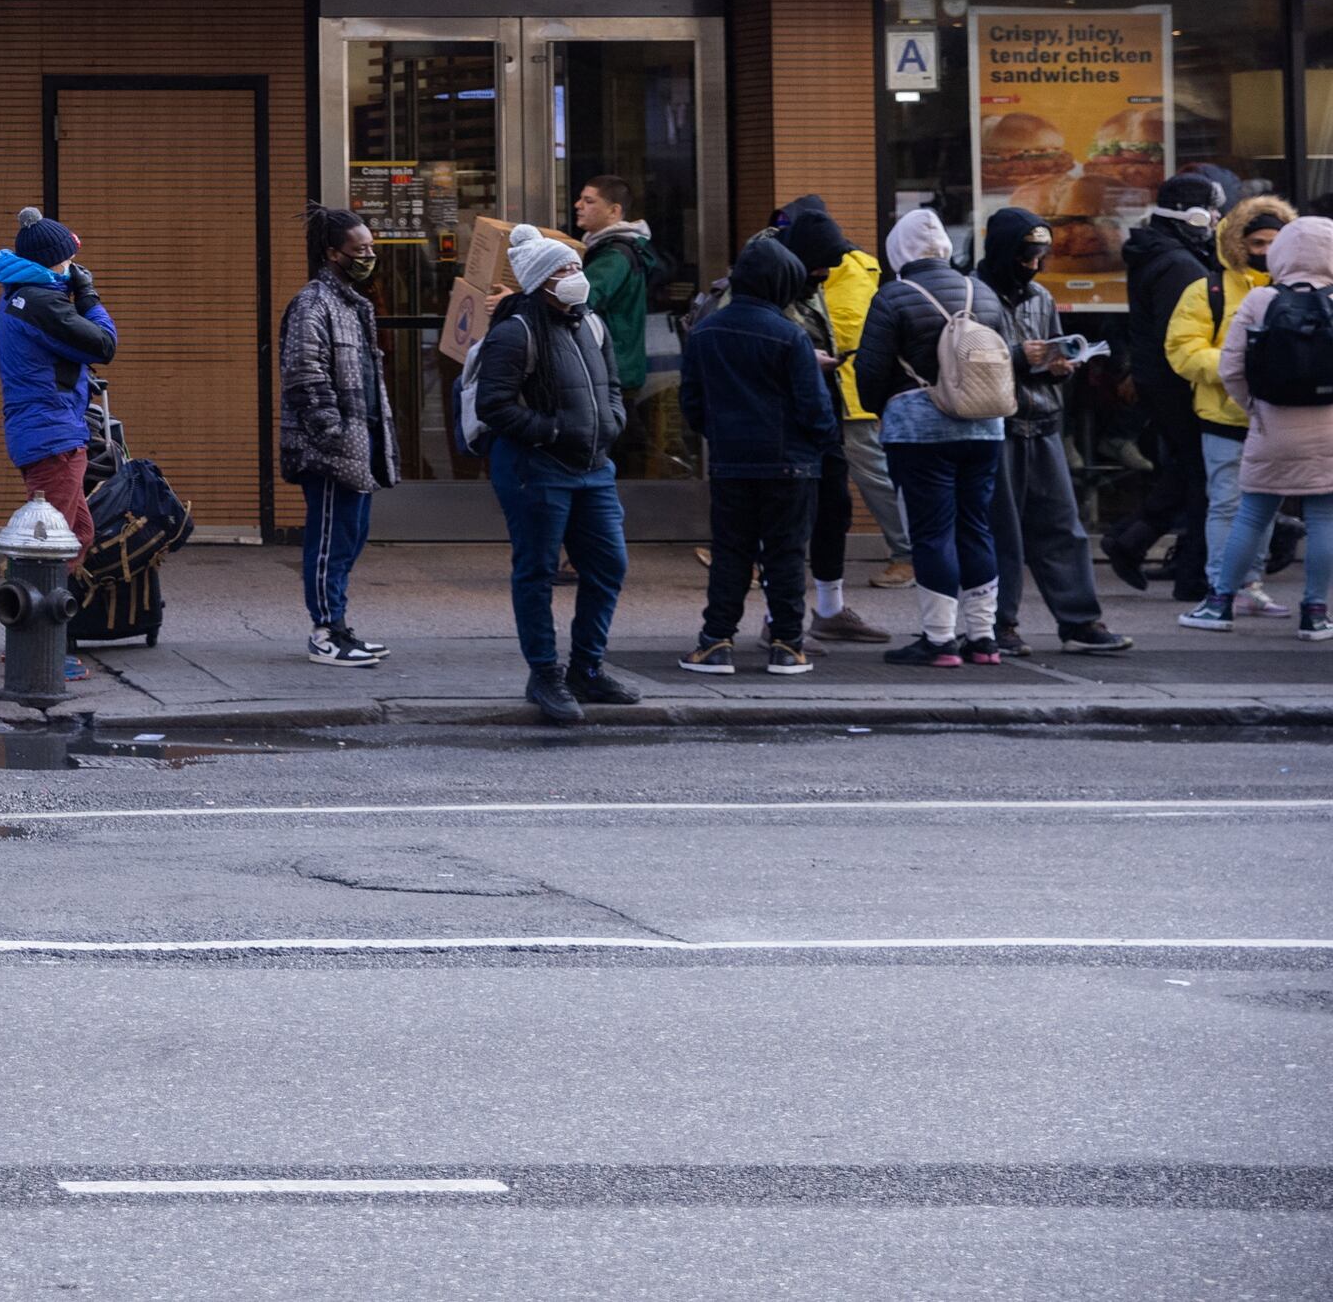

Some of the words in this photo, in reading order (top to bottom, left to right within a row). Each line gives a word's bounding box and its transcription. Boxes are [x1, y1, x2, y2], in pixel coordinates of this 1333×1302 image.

[990, 25, 1063, 45] Crispy,
[1067, 25, 1124, 46] juicy,
[896, 39, 927, 73] A
[990, 47, 1061, 63] tender
[1066, 46, 1153, 63] chicken
[990, 66, 1121, 83] sandwiches
